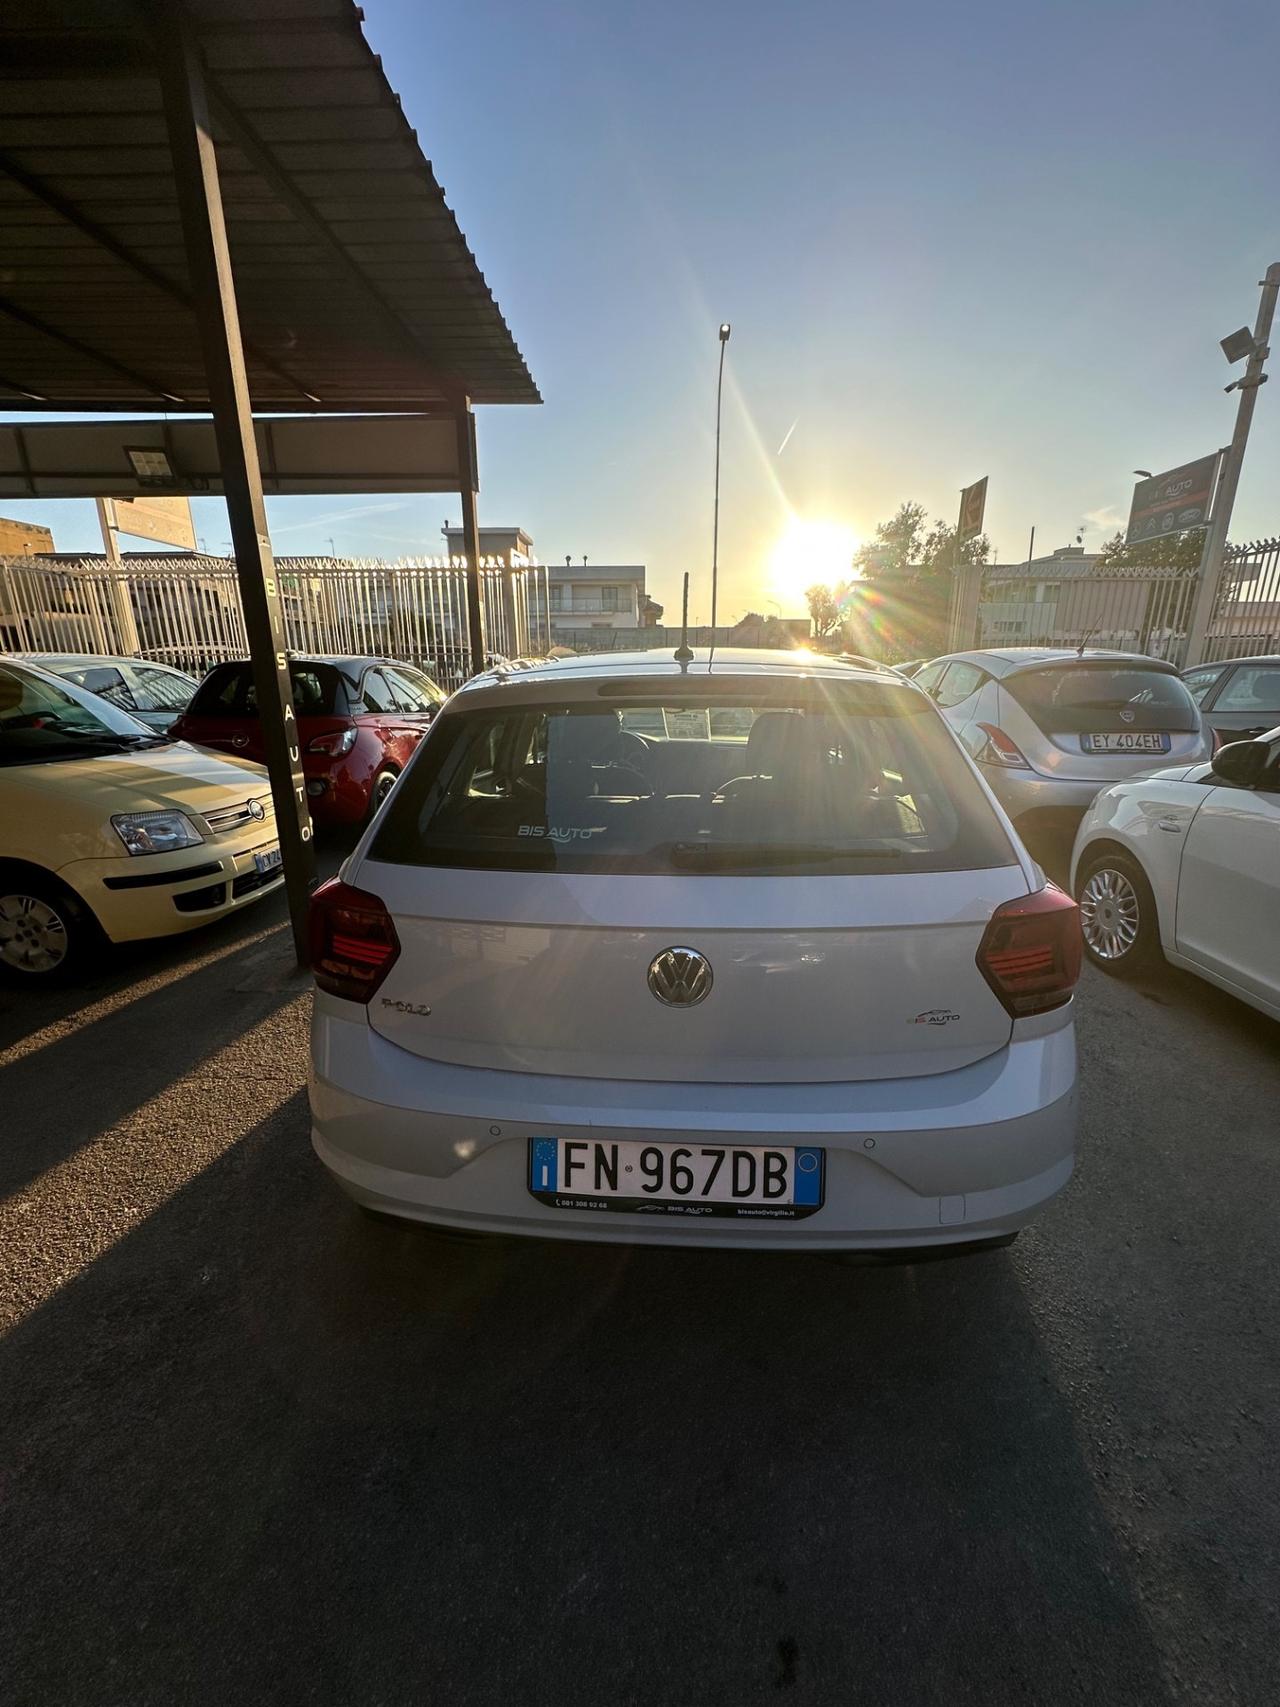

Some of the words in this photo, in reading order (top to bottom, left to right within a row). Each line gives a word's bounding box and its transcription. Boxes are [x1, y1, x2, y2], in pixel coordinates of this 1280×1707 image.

[1166, 480, 1193, 495] AUTO
[265, 577, 288, 671] BIS
[284, 704, 310, 841] AUTO
[1093, 735, 1110, 748] EY
[1117, 734, 1161, 748] 404EH
[517, 825, 545, 836] BIS
[546, 827, 592, 839] AUTO
[928, 1014, 960, 1023] AUTO
[564, 1142, 618, 1191] FN
[639, 1147, 788, 1198] 967DB
